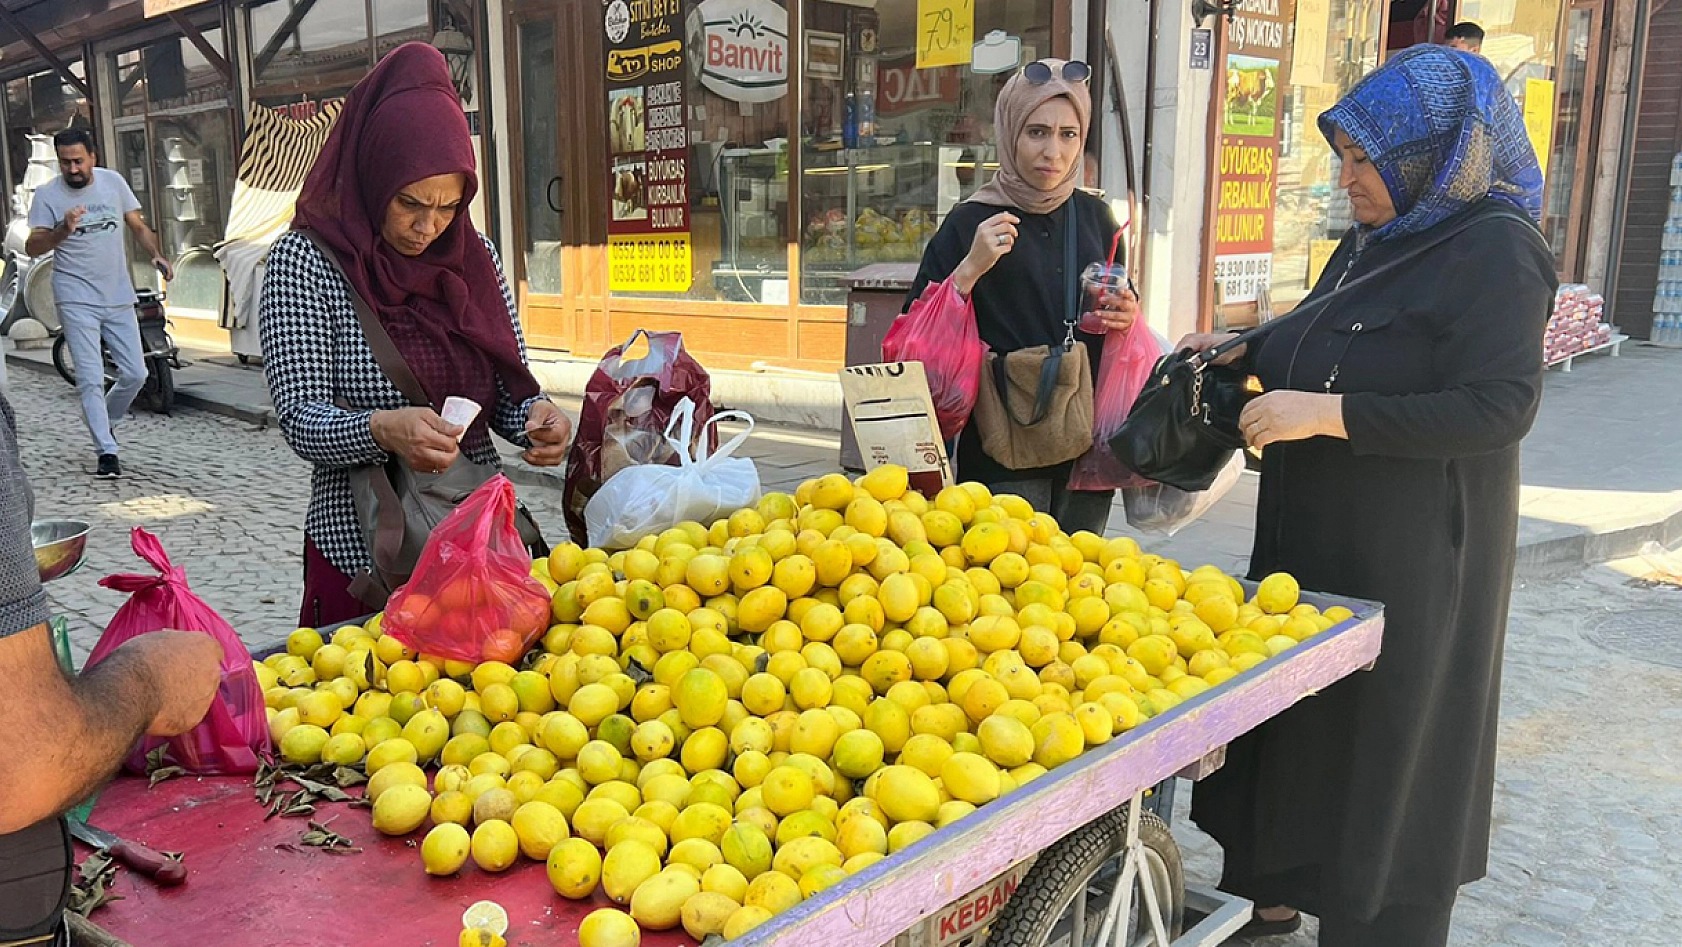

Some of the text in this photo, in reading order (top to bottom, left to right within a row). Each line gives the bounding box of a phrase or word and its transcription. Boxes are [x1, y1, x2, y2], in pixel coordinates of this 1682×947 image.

[708, 33, 783, 74] Banvit
[1194, 42, 1207, 56] 23
[651, 57, 682, 73] SHOP
[648, 156, 685, 183] BÜYÜKBAŞ
[1220, 138, 1273, 181] ÜYÜKBAŞ
[648, 184, 686, 205] KURBANLIK
[1218, 181, 1272, 209] URBANLIK
[652, 207, 684, 228] BULUNUR
[638, 240, 655, 259] 930
[939, 873, 1018, 941] KEBAN
